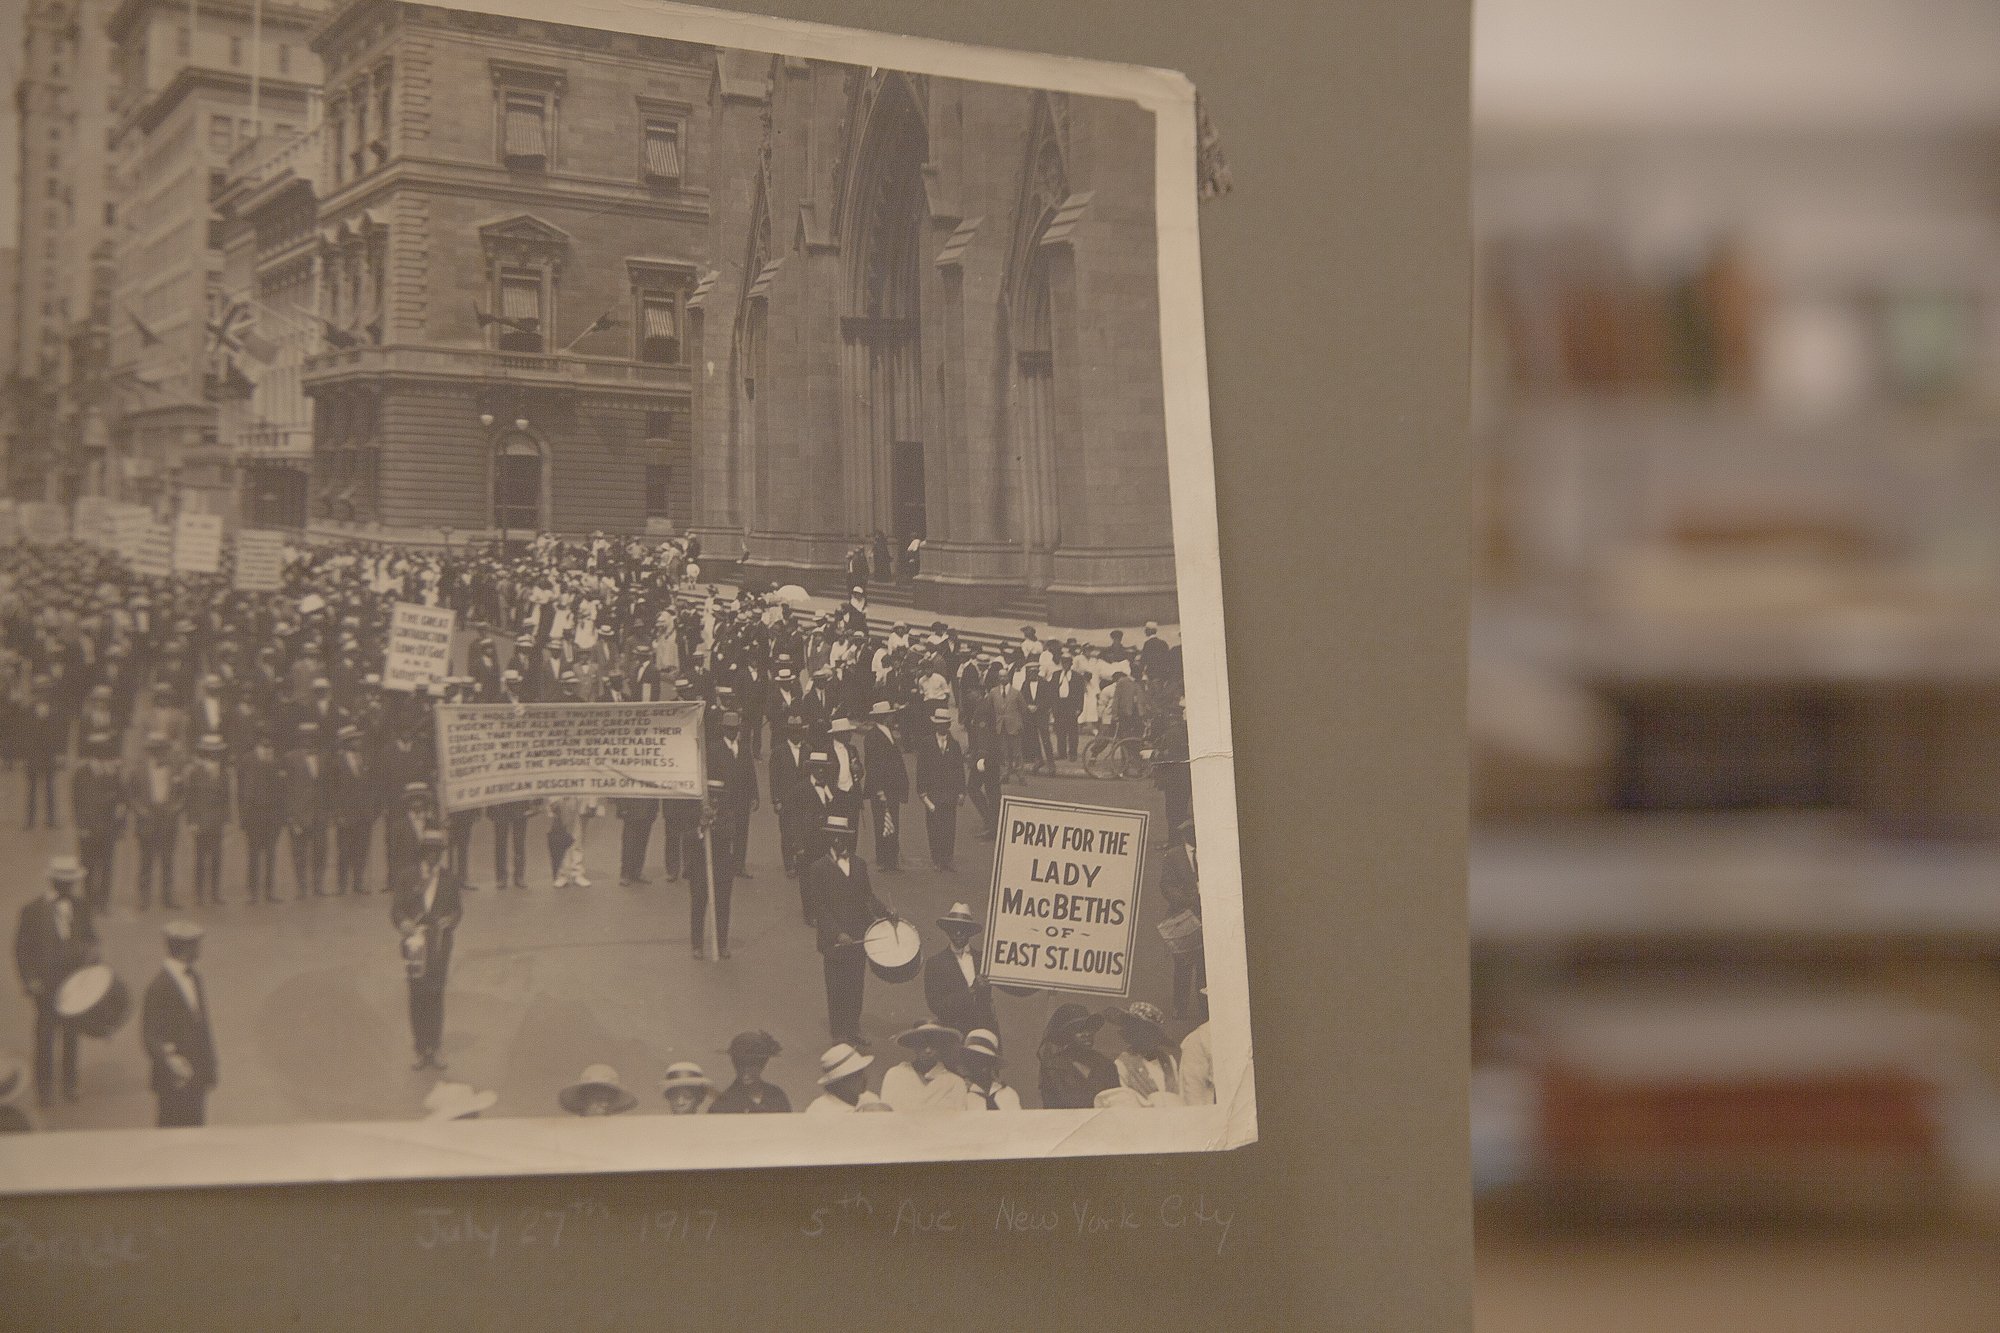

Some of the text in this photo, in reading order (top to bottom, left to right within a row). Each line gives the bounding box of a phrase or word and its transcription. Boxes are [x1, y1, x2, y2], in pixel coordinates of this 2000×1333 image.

[500, 720, 527, 729] THAT
[530, 720, 550, 728] ALL
[578, 718, 598, 727] ARE
[602, 718, 651, 726] CREATED
[516, 730, 544, 738] THEY
[653, 727, 682, 735] THEIR
[532, 738, 580, 748] CERTAIN
[586, 737, 667, 746] UNALIENABLE
[494, 751, 522, 760] THAT
[526, 748, 562, 758] AMONG
[567, 748, 598, 756] THESE
[604, 748, 628, 756] ARE
[498, 762, 522, 770] AND
[525, 760, 544, 768] THE
[548, 758, 590, 766] PURSUIT
[611, 758, 679, 768] HAPPINESS.
[485, 781, 532, 794] AFRICAN
[536, 778, 586, 790] DESCENT
[590, 778, 616, 788] TEAR
[1011, 820, 1130, 856] PRAY FOR THE
[1030, 858, 1102, 888] LADY
[1045, 926, 1075, 938] OF
[994, 940, 1041, 968] EAST
[412, 1208, 500, 1259] July
[638, 1208, 719, 1243] 1917
[800, 1191, 873, 1238] 5th
[993, 1196, 1059, 1234] New
[1072, 1199, 1141, 1237] York
[1159, 1193, 1235, 1256] City
